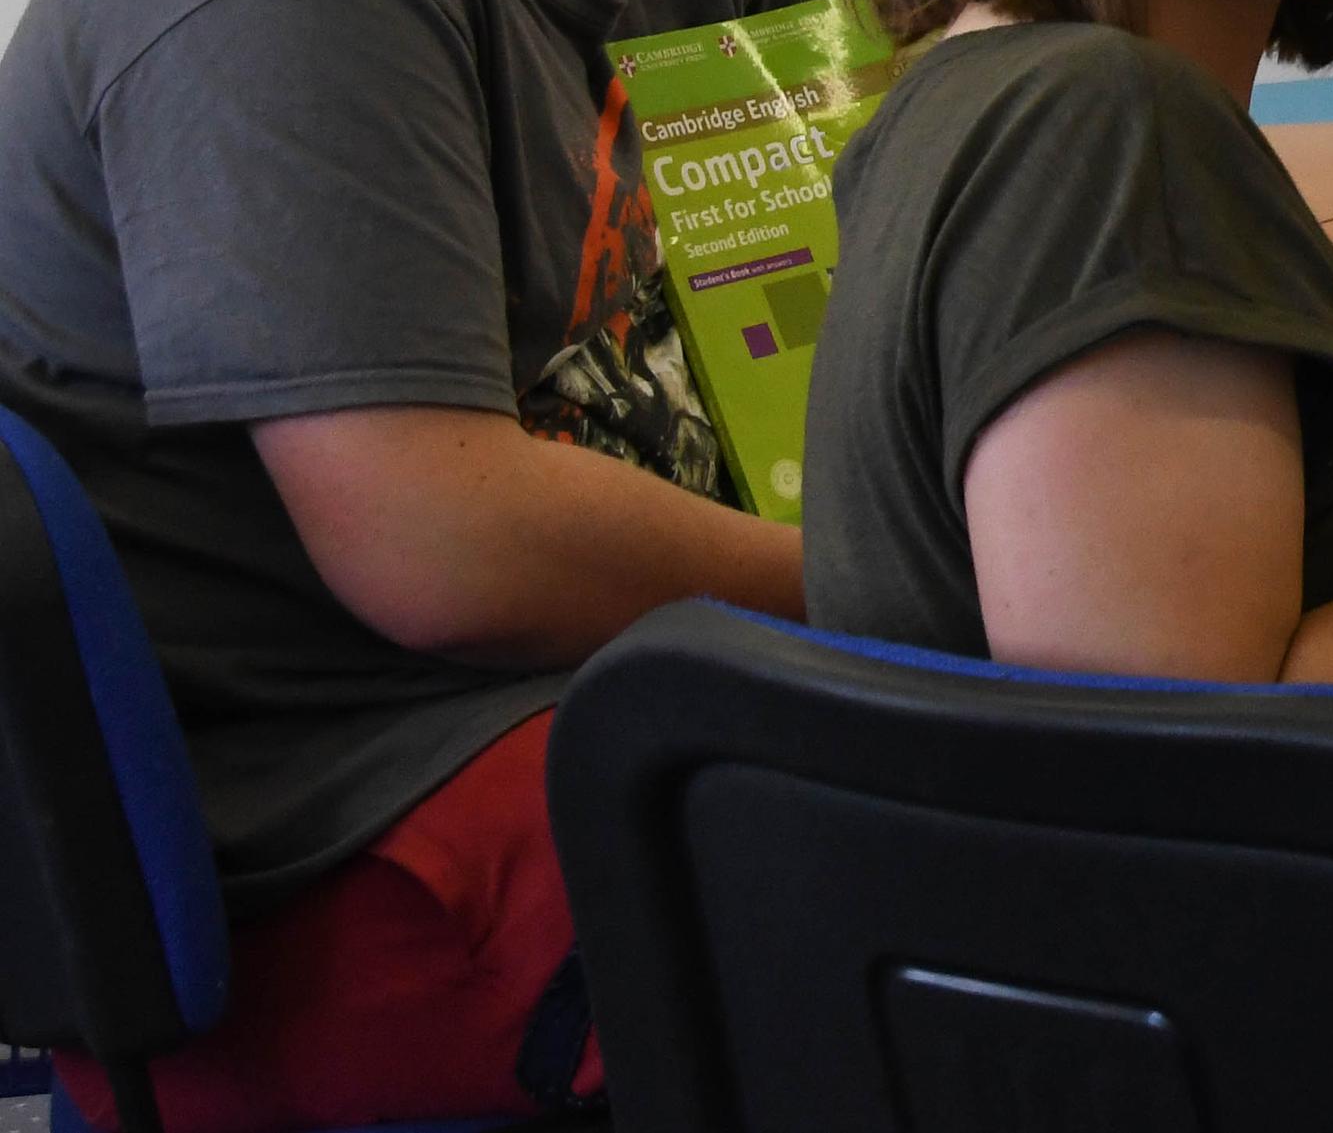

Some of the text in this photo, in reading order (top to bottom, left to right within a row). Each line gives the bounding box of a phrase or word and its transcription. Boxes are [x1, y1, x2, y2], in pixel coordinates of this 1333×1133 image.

[635, 44, 705, 65] CAMBRIDGE
[641, 86, 820, 142] Cambridge English
[653, 126, 834, 196] Compact
[671, 174, 833, 233] First for School
[684, 224, 789, 259] Second Edition
[693, 271, 730, 289] Student's
[731, 267, 750, 279] Book
